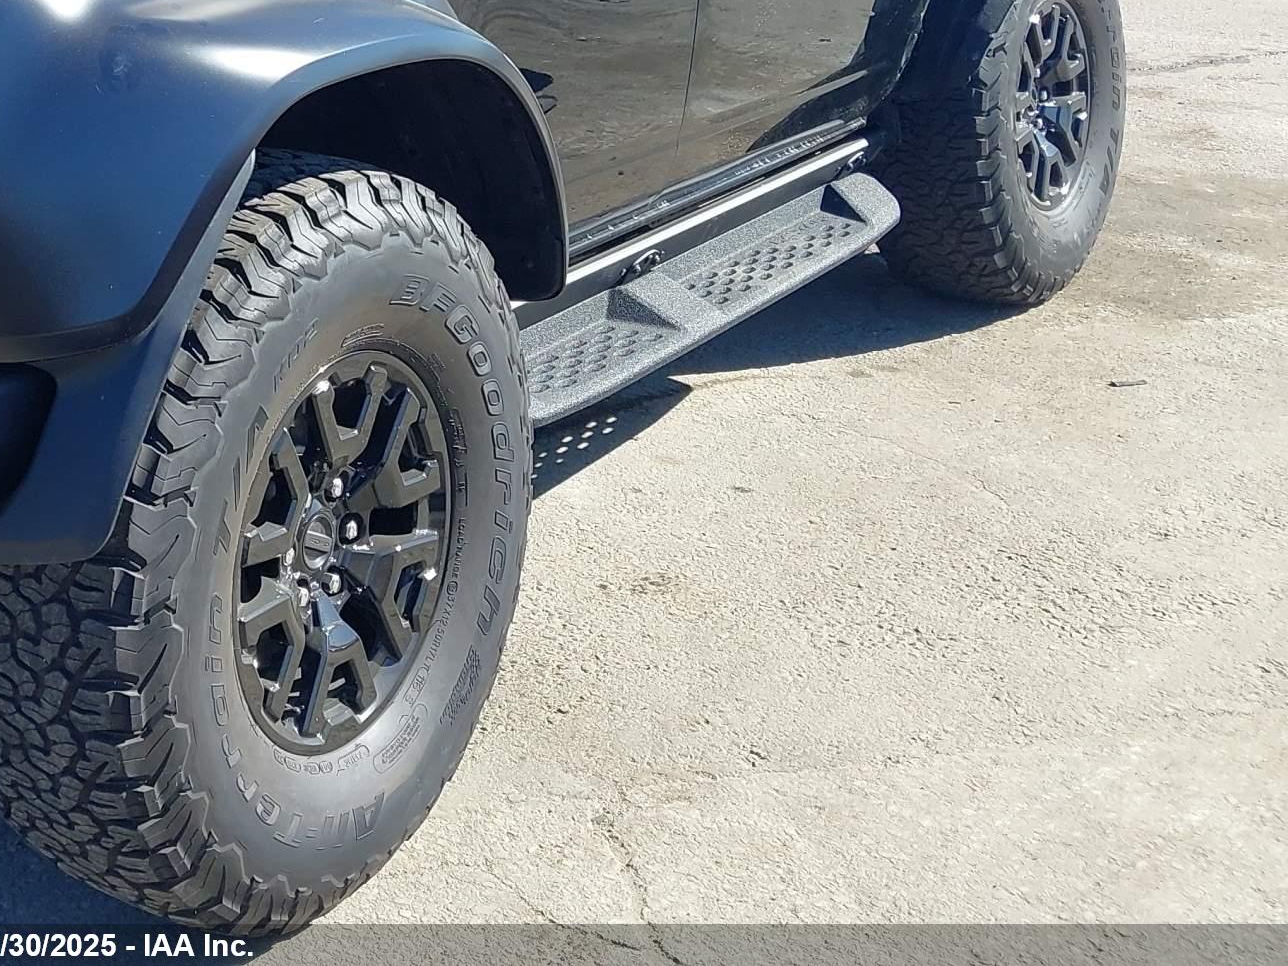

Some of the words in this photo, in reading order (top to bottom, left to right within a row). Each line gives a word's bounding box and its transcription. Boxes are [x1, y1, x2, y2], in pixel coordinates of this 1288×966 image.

[212, 404, 270, 556] T/A
[389, 273, 515, 636] BFGoodrich
[205, 592, 385, 850] All-Terrain
